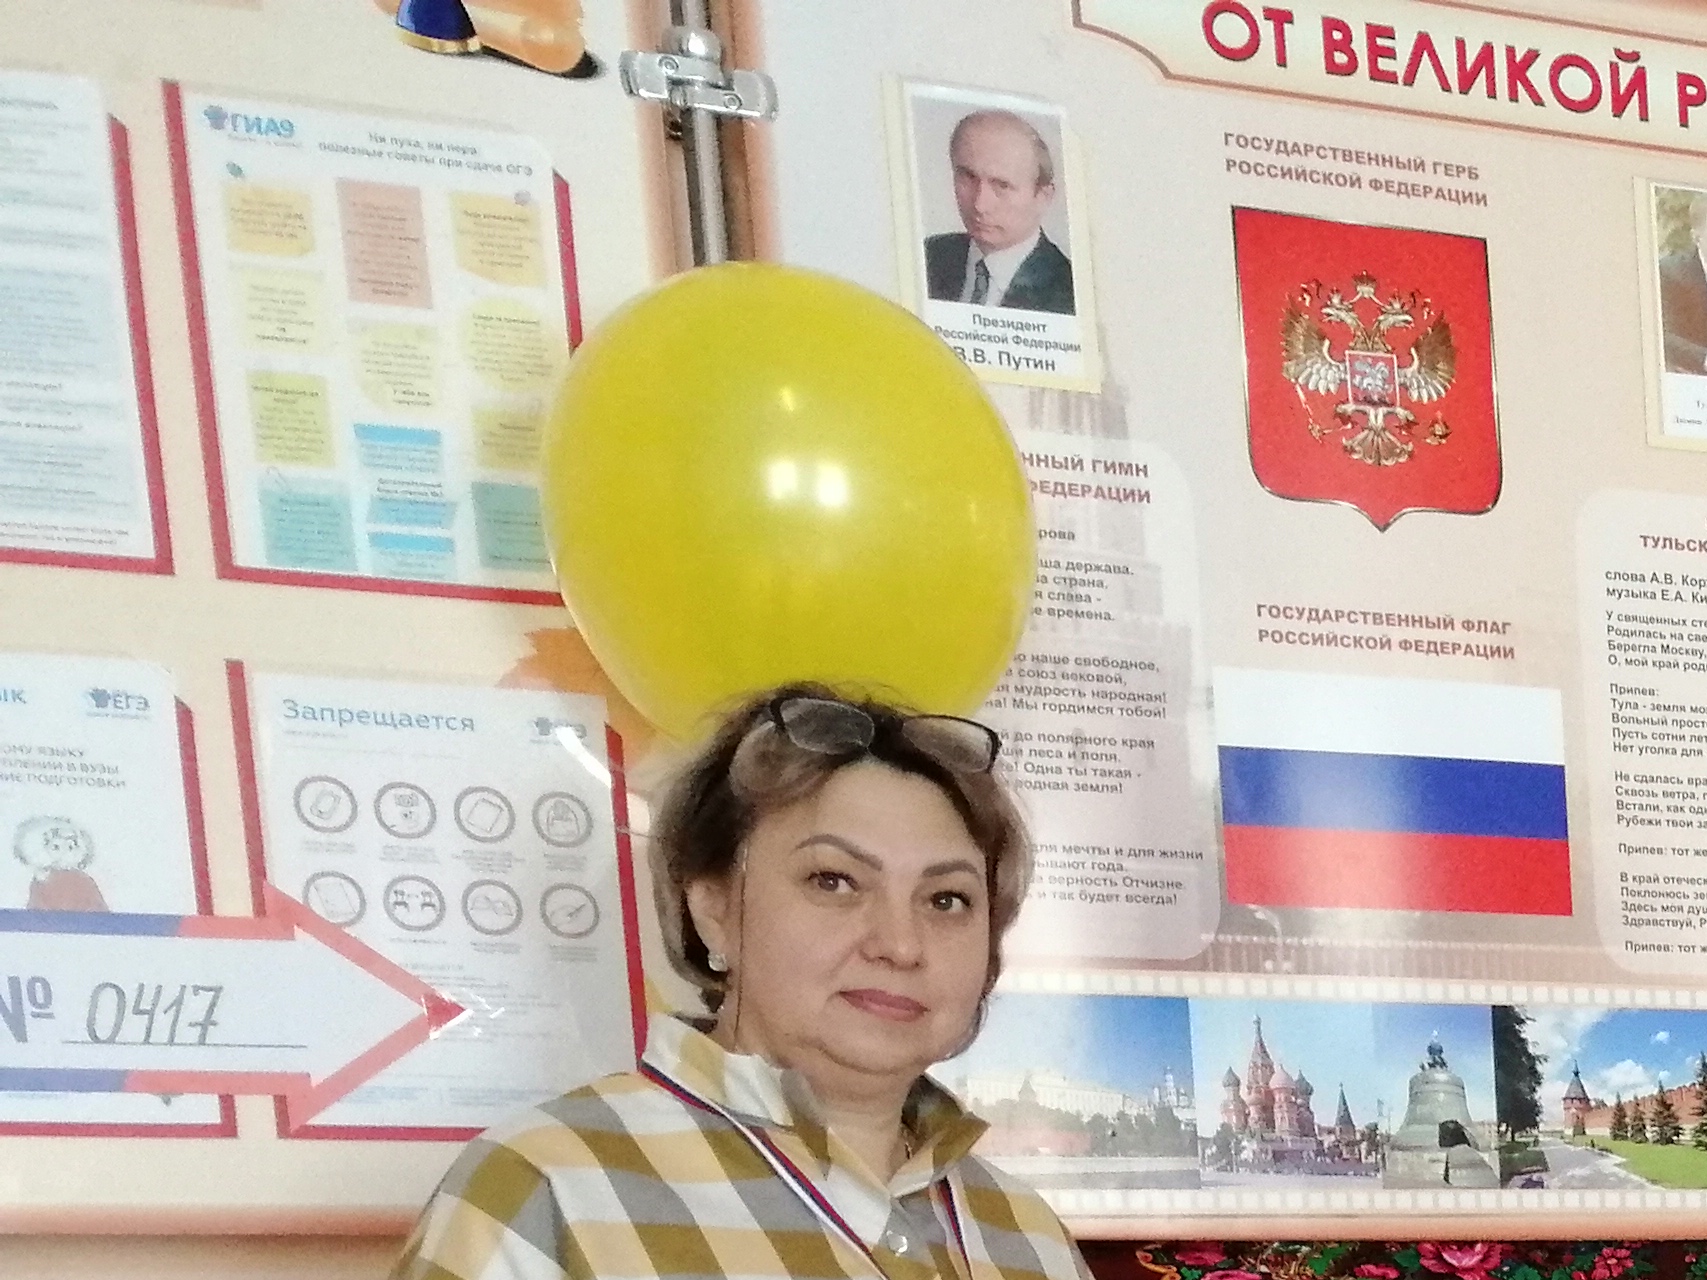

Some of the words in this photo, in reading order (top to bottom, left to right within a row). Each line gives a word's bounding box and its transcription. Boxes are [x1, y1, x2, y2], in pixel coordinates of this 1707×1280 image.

[1202, 0, 1295, 67] ОТ
[1322, 16, 1650, 122] ВЕЛИКОЙ
[230, 112, 295, 138] ГИА9
[1224, 131, 1425, 173] ГОСУДАРСТВЕННЫЙ
[1433, 161, 1479, 180] ГЕРБ
[1226, 158, 1362, 190] РОССИЙСКОЙ
[1369, 178, 1487, 207] ФЕДЕРАЦИИ
[973, 313, 1046, 333] Президент
[934, 325, 1008, 344] Российской
[1012, 335, 1081, 352] Федерации
[999, 351, 1055, 371] Путин
[1092, 459, 1148, 478] ГИМН
[1605, 570, 1645, 583] слова
[1650, 572, 1676, 586] А.В.
[1607, 587, 1656, 600] музыка
[1257, 603, 1455, 631] ГОСУДАРСТВЕННЫЙ
[1461, 619, 1511, 635] ФЛАГ
[1617, 613, 1687, 626] священных
[1607, 624, 1666, 640] Родилась
[1670, 632, 1683, 642] на
[1258, 629, 1391, 651] РОССИЙСКОЙ
[1399, 638, 1514, 661] ФЕДЕРАЦИИ
[1608, 639, 1656, 654] Берегла
[1661, 643, 1706, 659] Москву,
[1625, 657, 1648, 667] мой
[1652, 659, 1679, 670] край
[1014, 684, 1086, 698] мудрость
[1092, 690, 1166, 703] народная!
[1610, 683, 1658, 696] Припев:
[1012, 697, 1037, 711] Мы
[1043, 702, 1113, 715] гордимся
[1118, 706, 1165, 718] тобой!
[1611, 697, 1638, 712] Тула
[1651, 703, 1686, 713] земля
[283, 698, 474, 733] Запрещается
[1612, 712, 1667, 726] Вольный
[1038, 733, 1117, 746] полярного
[1122, 738, 1154, 749] края
[86, 982, 223, 1046] 0417
